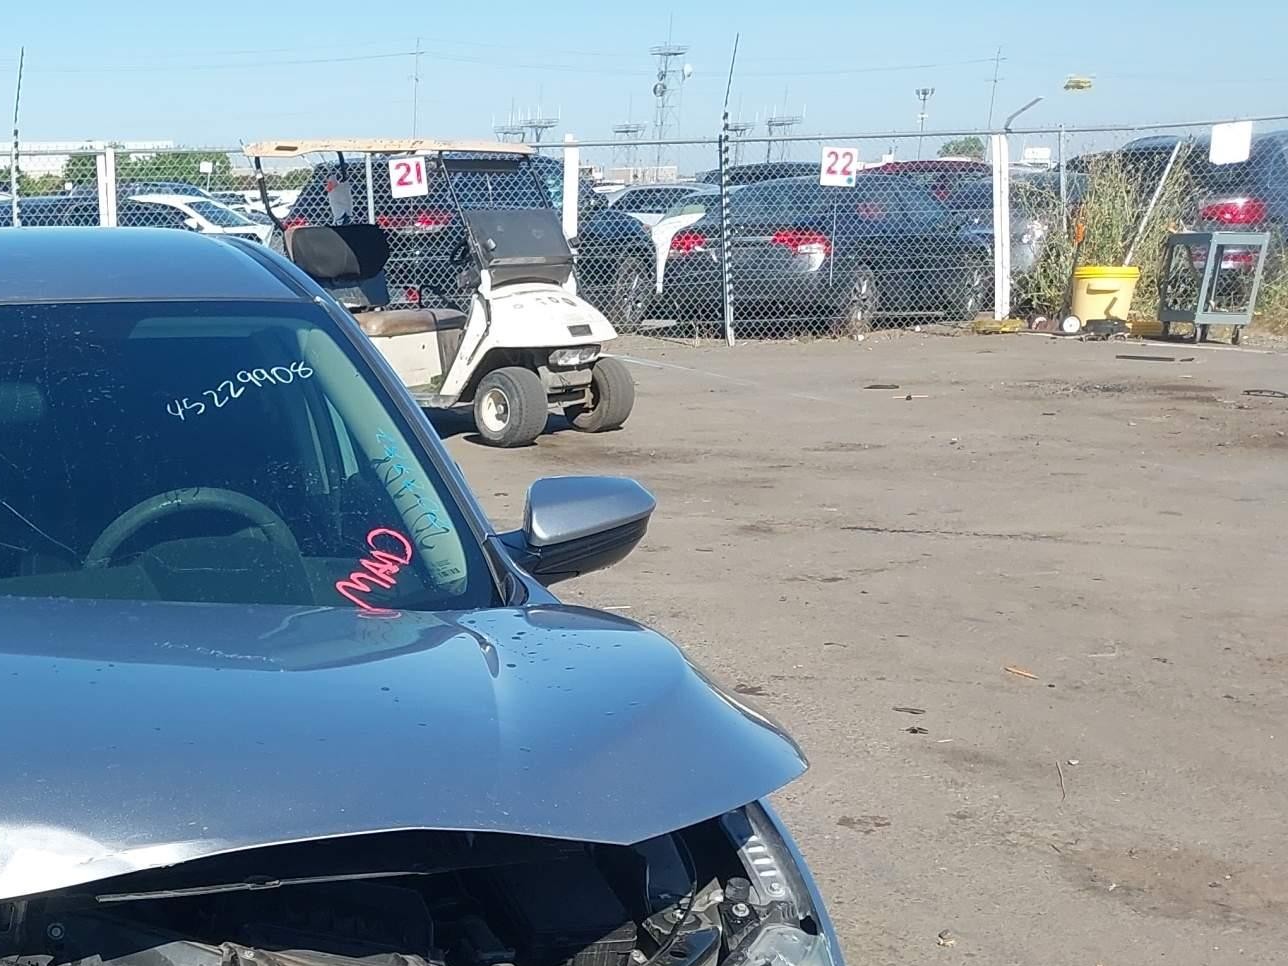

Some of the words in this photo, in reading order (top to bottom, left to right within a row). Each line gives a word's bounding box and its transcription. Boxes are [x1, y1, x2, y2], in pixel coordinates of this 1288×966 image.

[394, 161, 423, 186] 21
[826, 150, 854, 176] 22
[166, 360, 313, 421] 45229908
